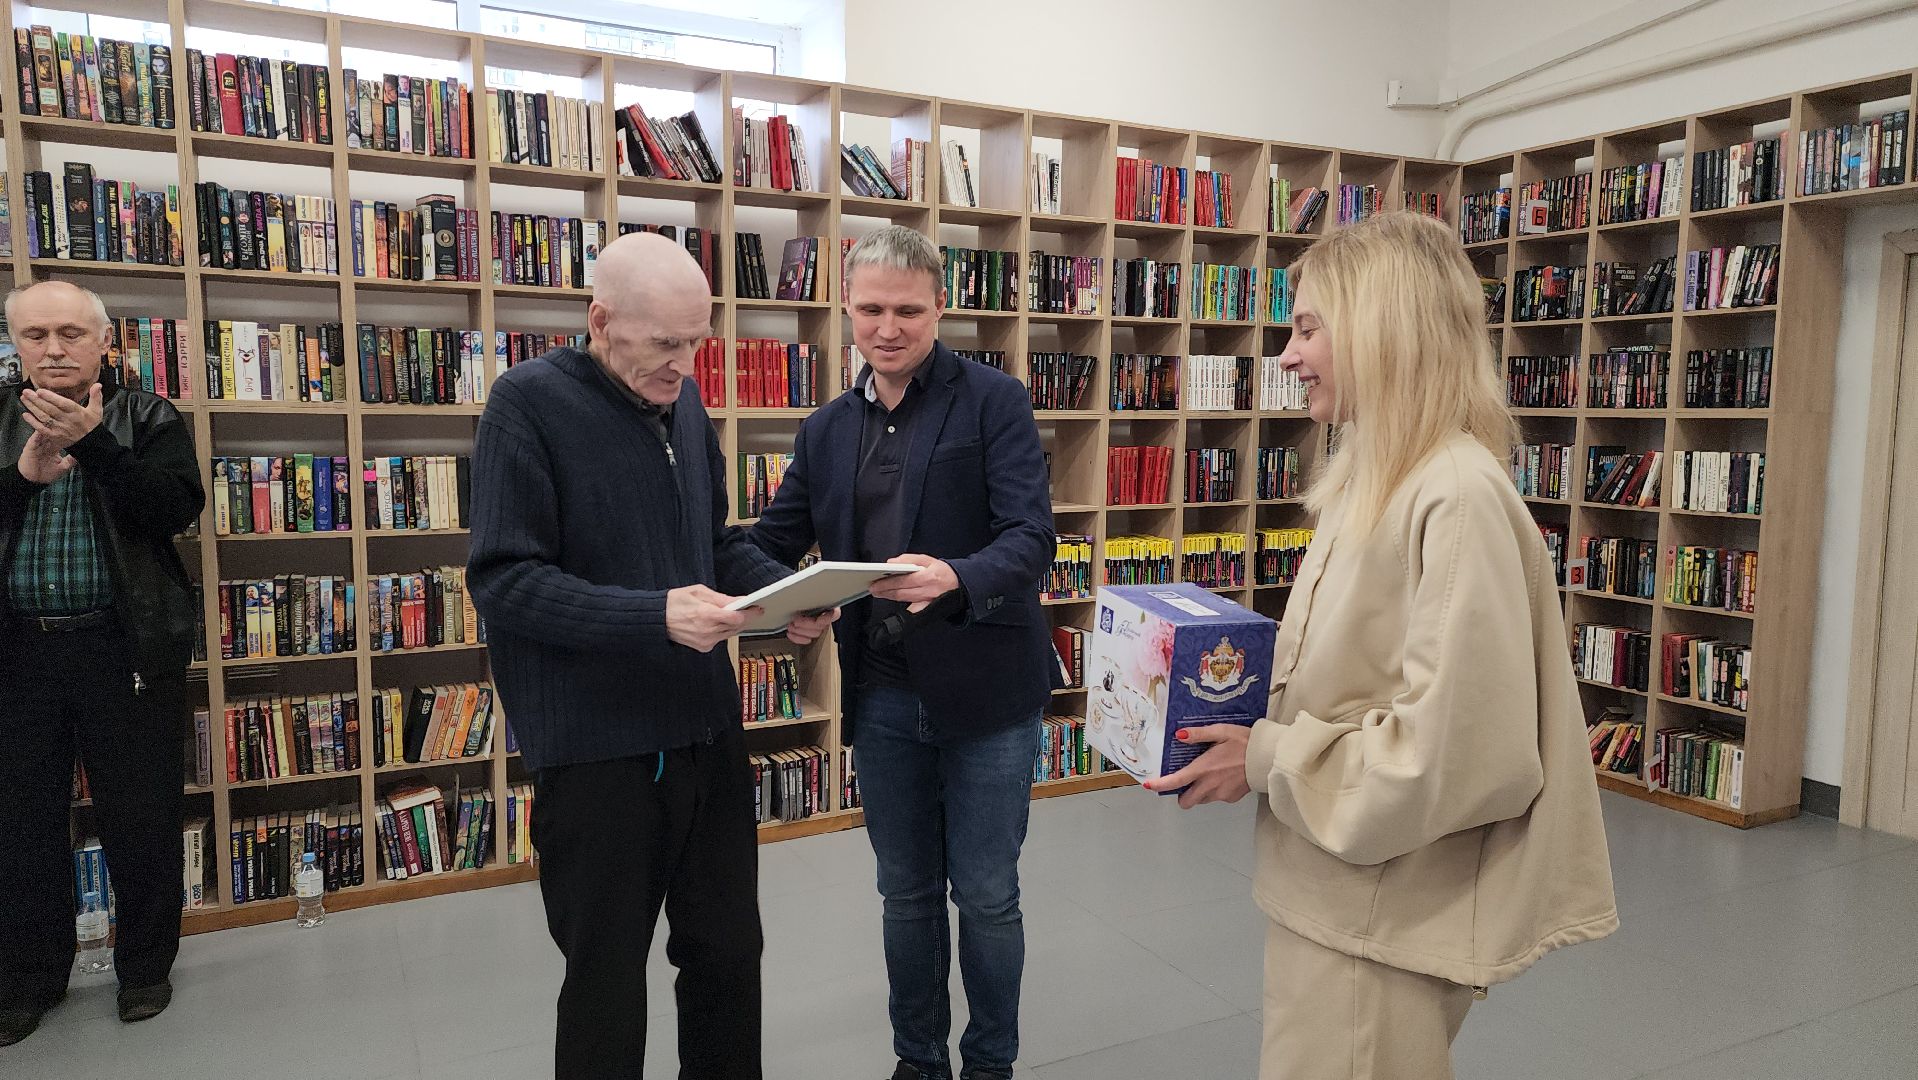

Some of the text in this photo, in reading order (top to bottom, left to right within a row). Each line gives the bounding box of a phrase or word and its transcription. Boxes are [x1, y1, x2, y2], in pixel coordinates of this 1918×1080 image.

[1535, 210, 1543, 225] Б
[155, 335, 164, 364] СИЯНИЕ
[223, 337, 231, 371] КРИСТИНА
